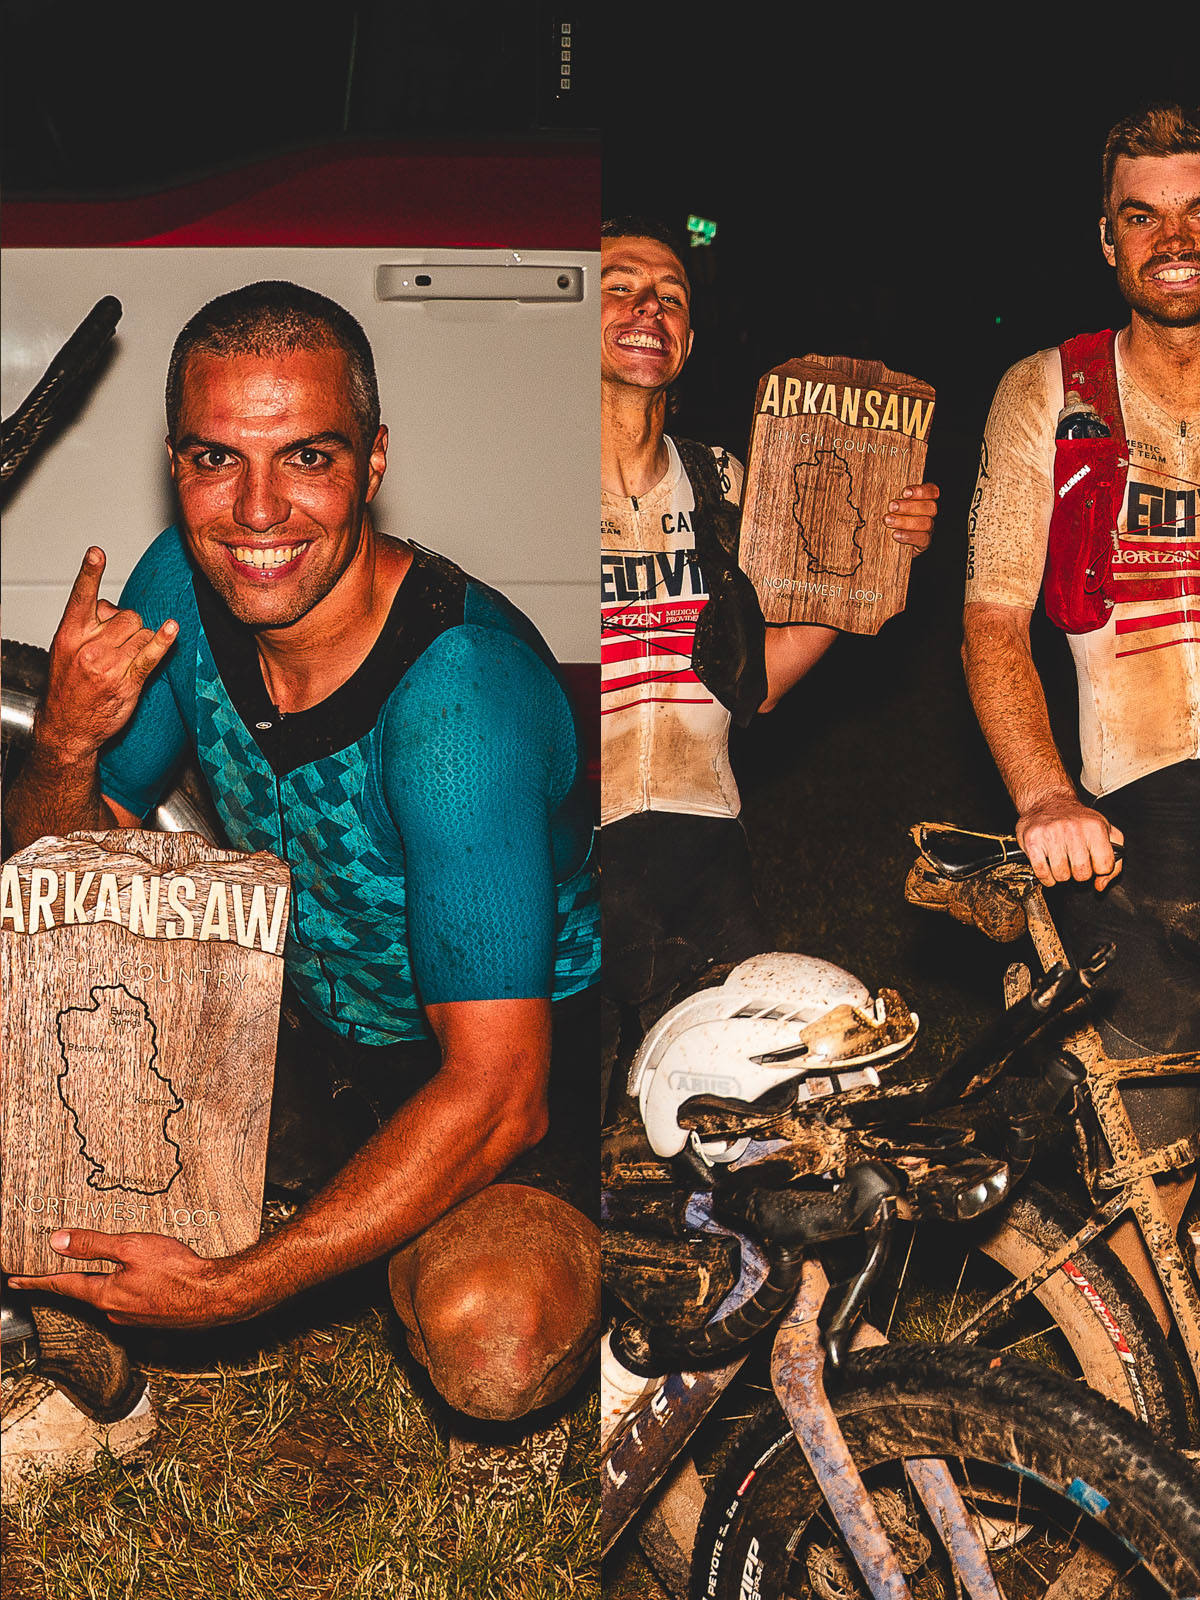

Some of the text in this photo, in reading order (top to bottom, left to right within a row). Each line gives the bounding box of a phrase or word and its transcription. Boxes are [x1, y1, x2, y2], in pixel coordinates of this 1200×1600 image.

[760, 374, 936, 441] ARKANSAW
[833, 437, 909, 459] COUNTRY
[1138, 450, 1167, 464] TEAM
[1058, 464, 1091, 498] SALOMON
[661, 511, 694, 534] CA
[763, 576, 844, 598] NORTHWEST
[849, 588, 883, 602] LOOP
[665, 608, 700, 617] MEDICAL
[1, 864, 288, 955] ARKANSAW
[119, 960, 250, 990] COUNTRY
[109, 1017, 142, 1029] Springs
[110, 1006, 141, 1017] Eureka
[677, 1075, 731, 1095] ABUS
[134, 1096, 171, 1107] Kingston
[13, 1193, 221, 1227] NORTHWEST LOOP
[1083, 1286, 1121, 1342] vittoria
[1127, 1367, 1149, 1424] PEYOTE
[707, 1538, 724, 1598] PEYOTE
